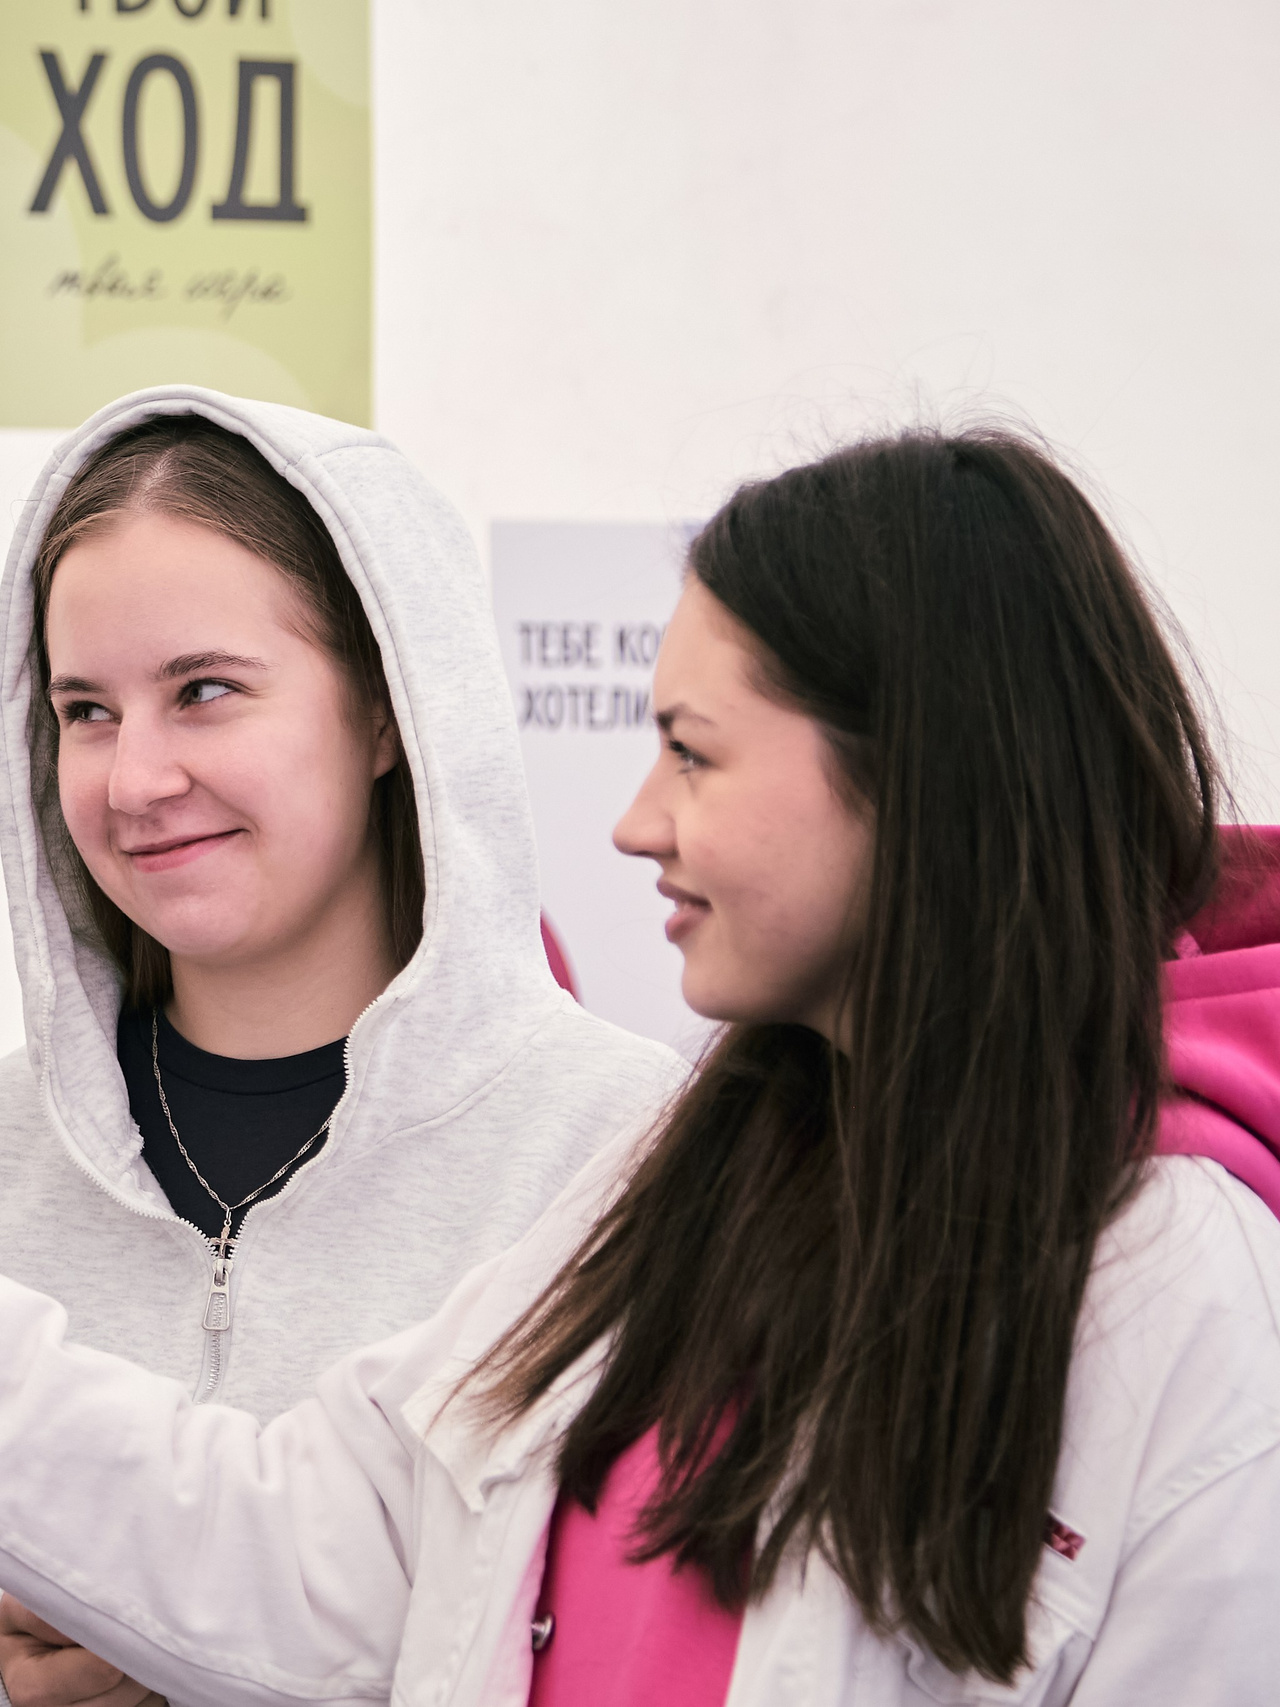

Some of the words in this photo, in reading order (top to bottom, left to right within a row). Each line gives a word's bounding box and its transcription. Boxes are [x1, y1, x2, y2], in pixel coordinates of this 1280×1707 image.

[28, 50, 309, 224] ХОД
[519, 621, 601, 668] ТЕБЕ
[616, 622, 666, 666] КО
